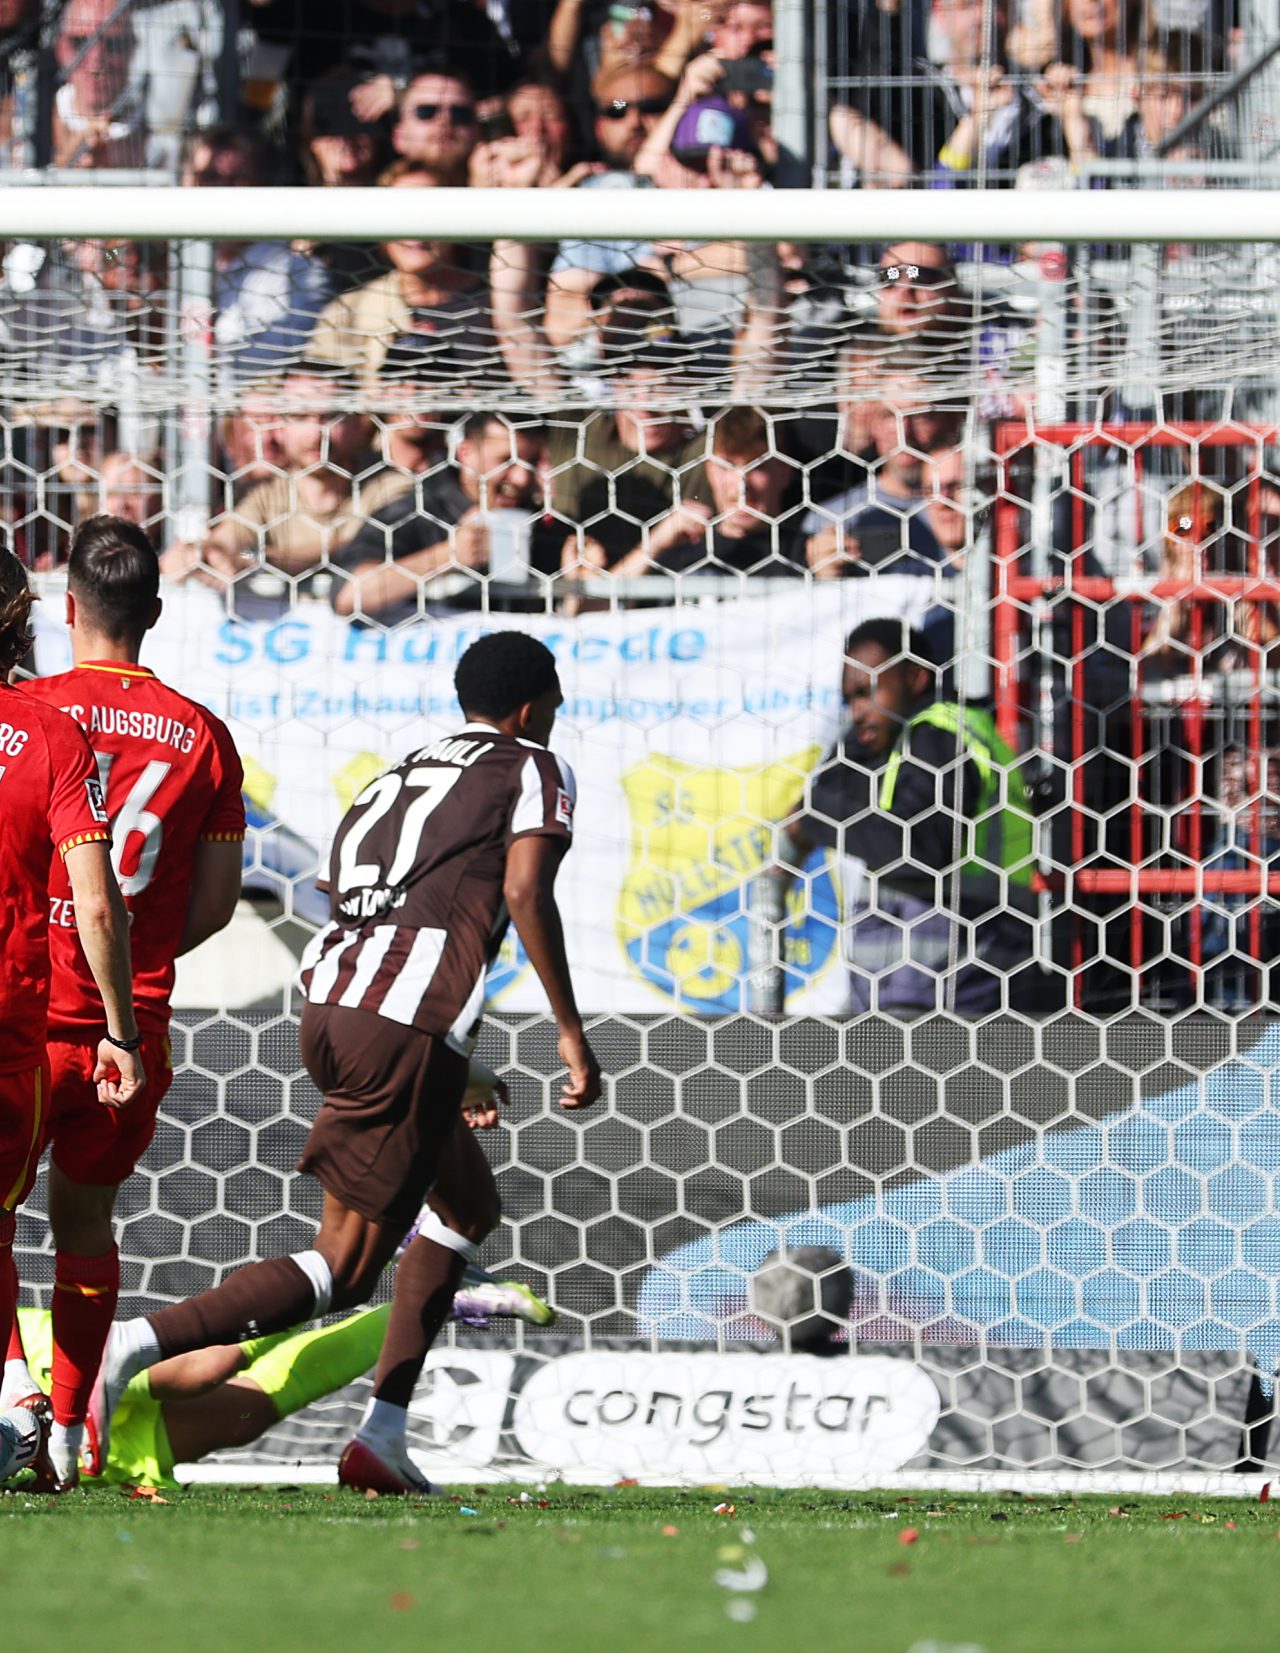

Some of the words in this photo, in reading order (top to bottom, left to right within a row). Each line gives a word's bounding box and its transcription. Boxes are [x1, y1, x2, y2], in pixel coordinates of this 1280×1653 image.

[213, 620, 311, 665] SG
[90, 705, 196, 754] AUGSBURG
[337, 766, 464, 894] 27
[563, 1380, 893, 1447] congstar
